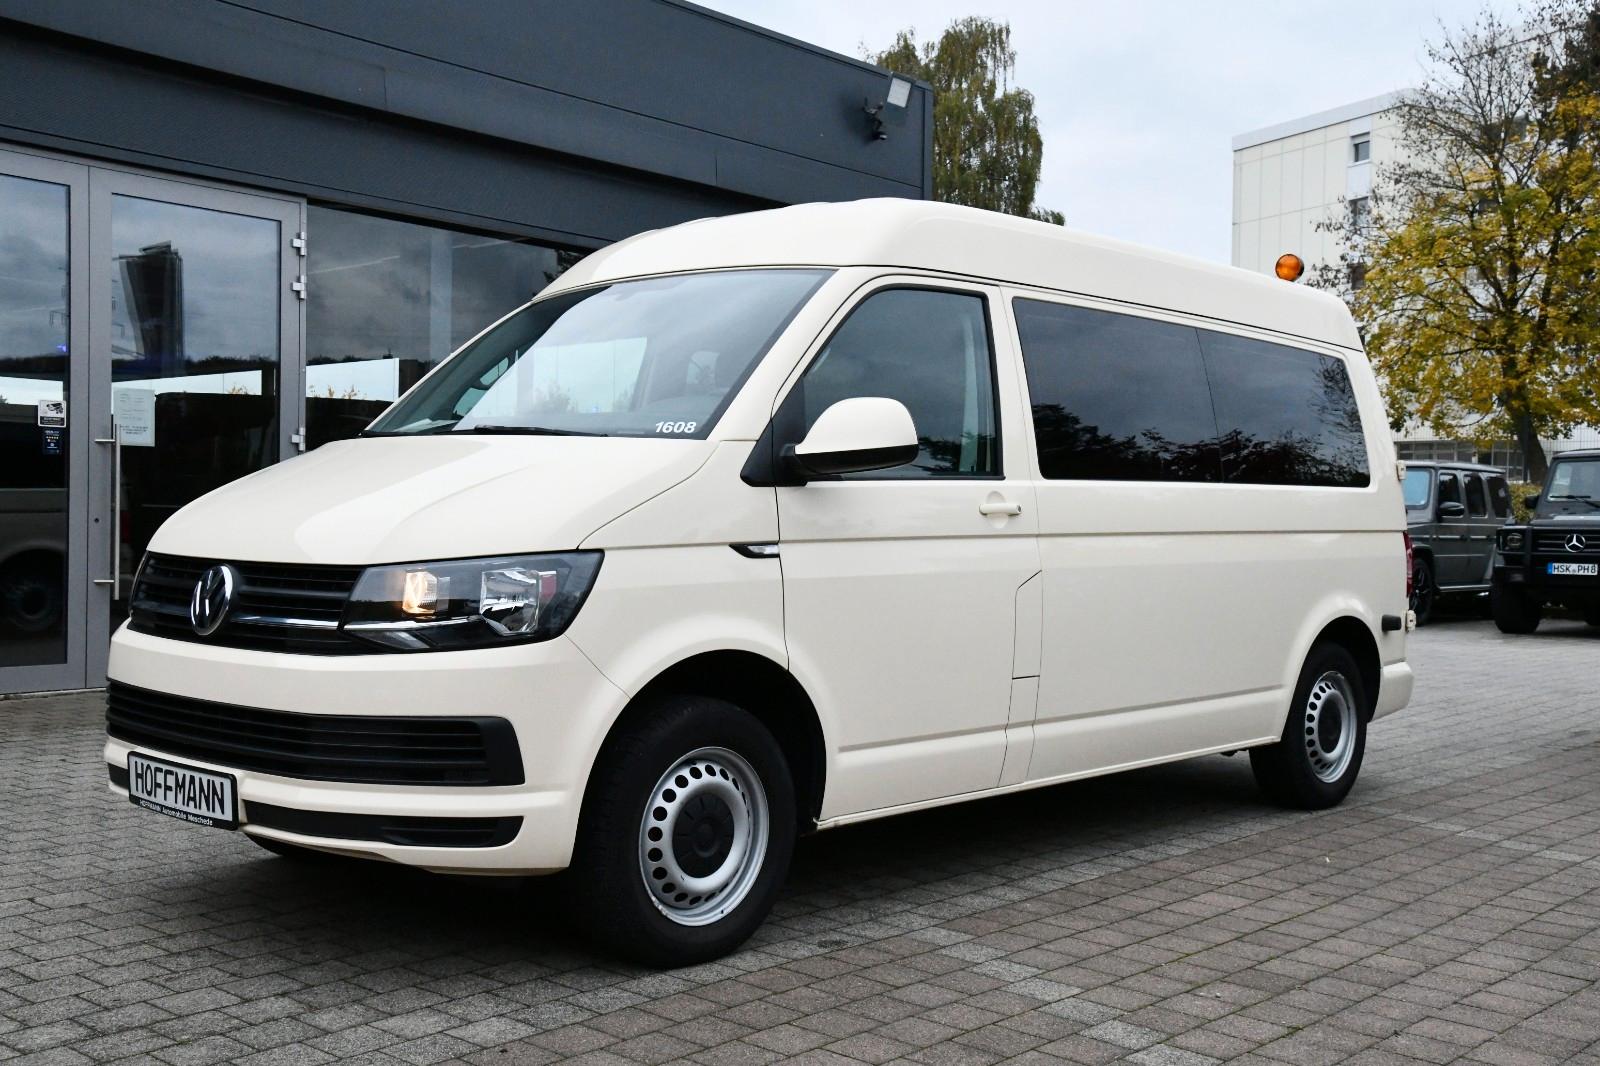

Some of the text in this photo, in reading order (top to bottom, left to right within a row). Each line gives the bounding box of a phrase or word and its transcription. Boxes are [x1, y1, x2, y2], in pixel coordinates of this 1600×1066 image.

[655, 421, 697, 433] 1608
[1553, 564, 1571, 573] HSK
[134, 760, 225, 815] HOFFMANN
[140, 800, 213, 825] HOFFMANN Automobile Meschede
